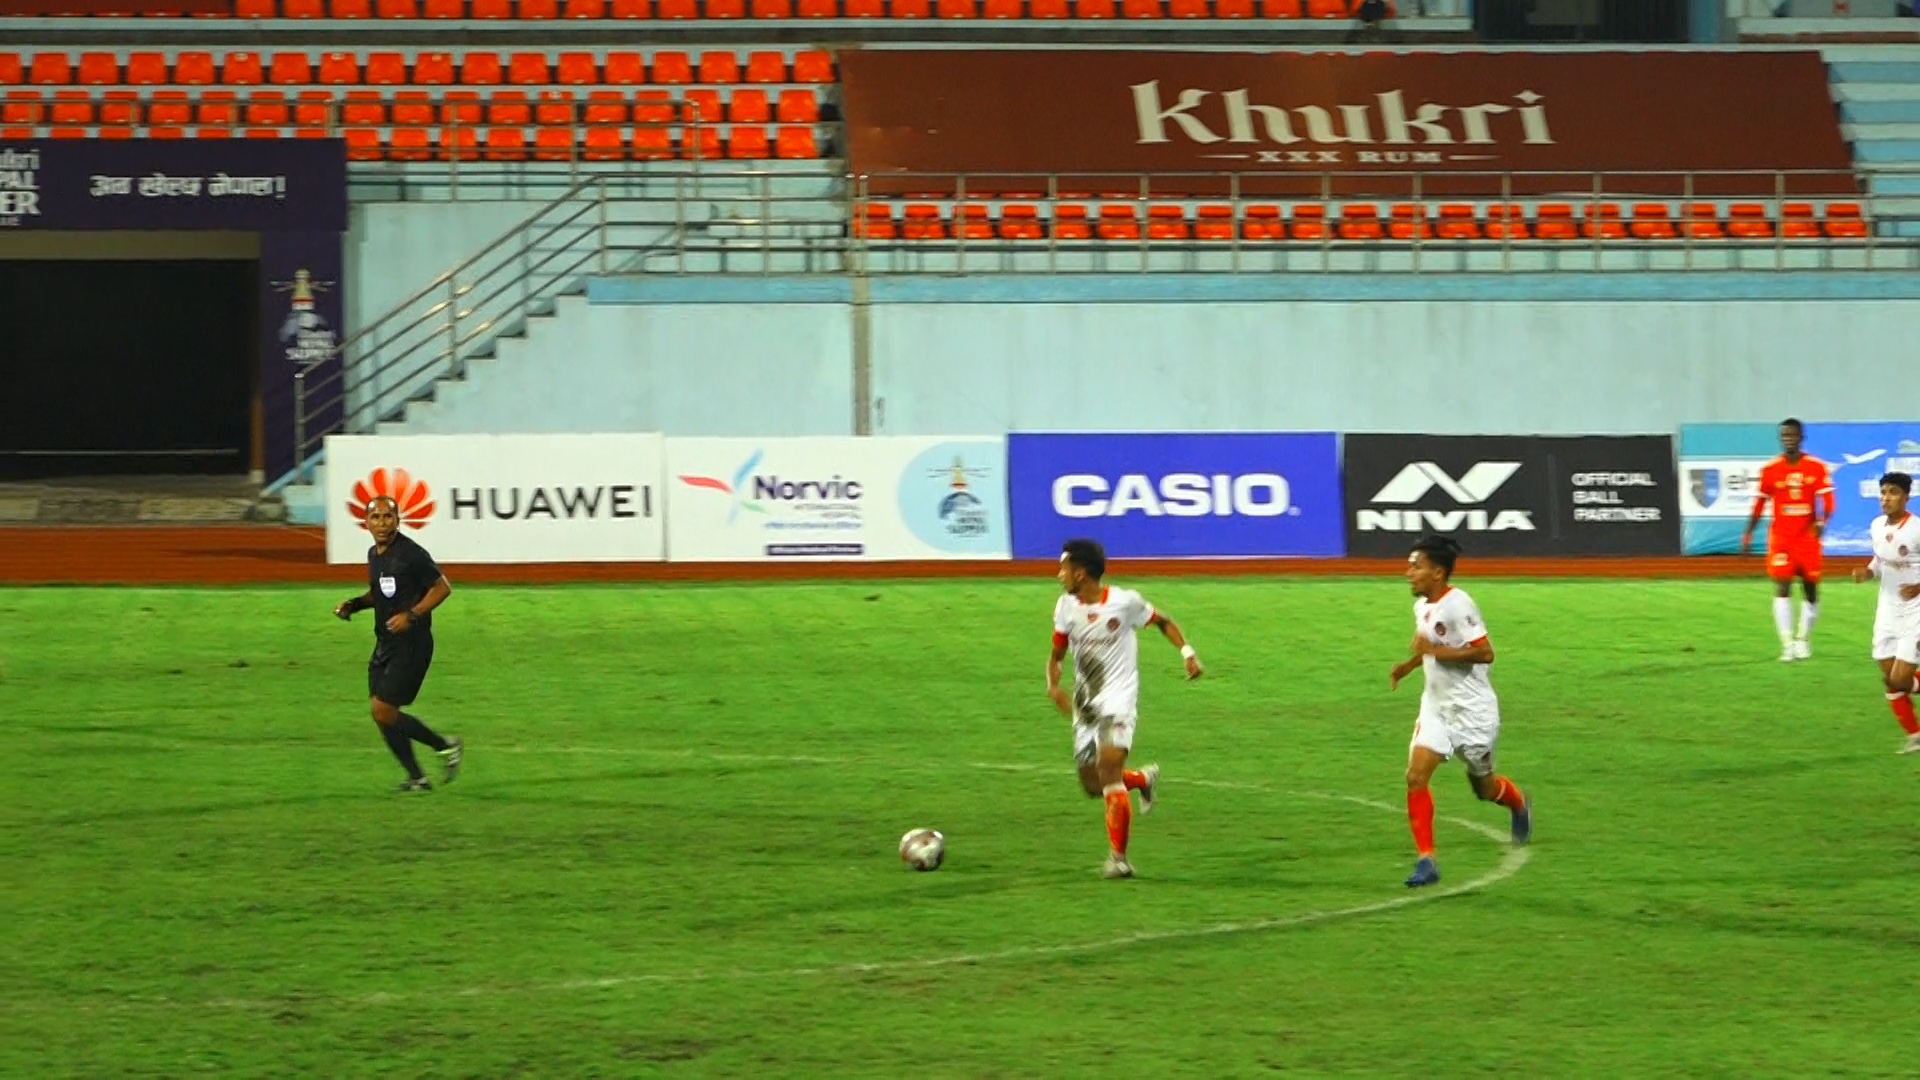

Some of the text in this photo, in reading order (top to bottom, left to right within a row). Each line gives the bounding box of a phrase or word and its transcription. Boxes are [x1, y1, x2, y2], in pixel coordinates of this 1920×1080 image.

[1129, 79, 1557, 145] Khukri
[1255, 150, 1443, 164] XXX RUM
[754, 474, 863, 500] Norvic
[1571, 472, 1658, 487] OFFICIAL
[450, 484, 653, 520] HUAWEI
[1052, 473, 1291, 517] CASIO
[1572, 490, 1625, 505] BALL
[1356, 508, 1536, 531] NIVIA
[1573, 507, 1662, 522] PARTNER
